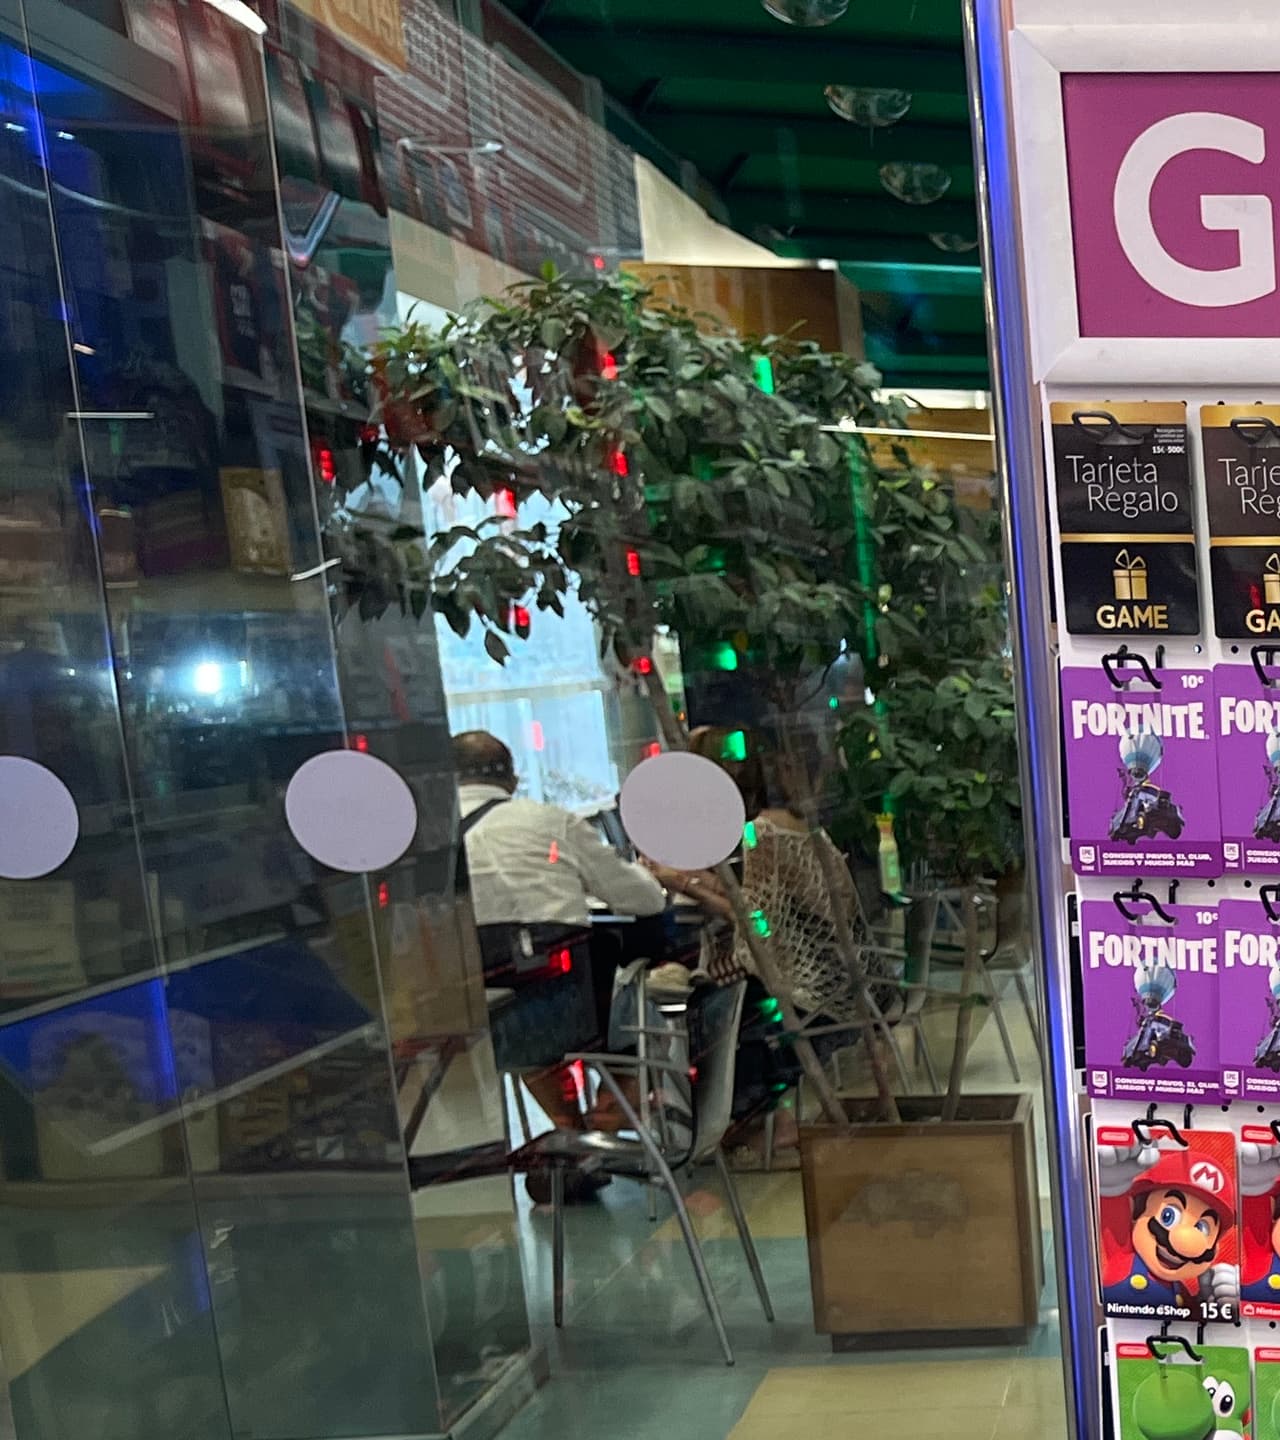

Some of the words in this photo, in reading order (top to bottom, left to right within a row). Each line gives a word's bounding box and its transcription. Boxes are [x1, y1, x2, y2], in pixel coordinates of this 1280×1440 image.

[1066, 456, 1157, 489] Tarjeta
[1088, 484, 1178, 518] Regalo
[1096, 605, 1168, 629] GAME
[1071, 700, 1206, 739] FORTNITE
[1107, 1303, 1154, 1316] Nintendo
